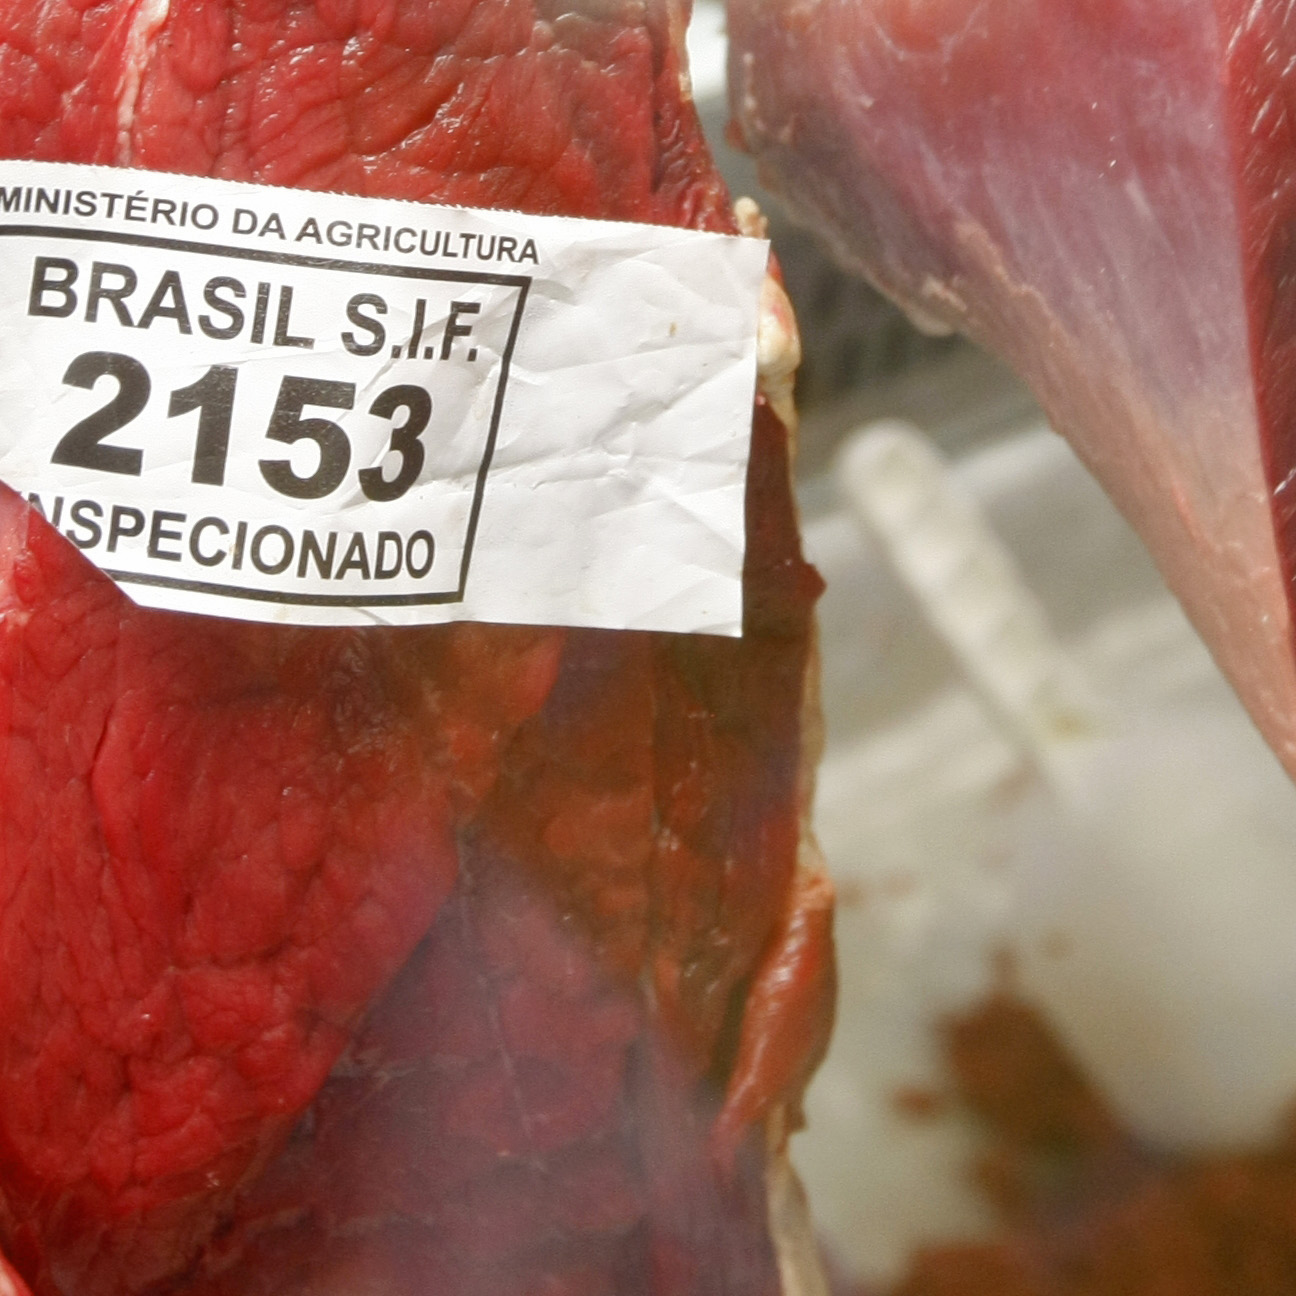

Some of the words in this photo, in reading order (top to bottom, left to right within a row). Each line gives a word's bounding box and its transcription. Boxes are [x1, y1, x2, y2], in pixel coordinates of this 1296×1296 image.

[233, 209, 287, 240] DA
[295, 216, 540, 265] AGRICULTURA
[28, 256, 316, 349] BRASIL
[340, 293, 482, 363] S.I.F.
[50, 351, 434, 503] 2153
[16, 491, 436, 580] NSPECIONADO
